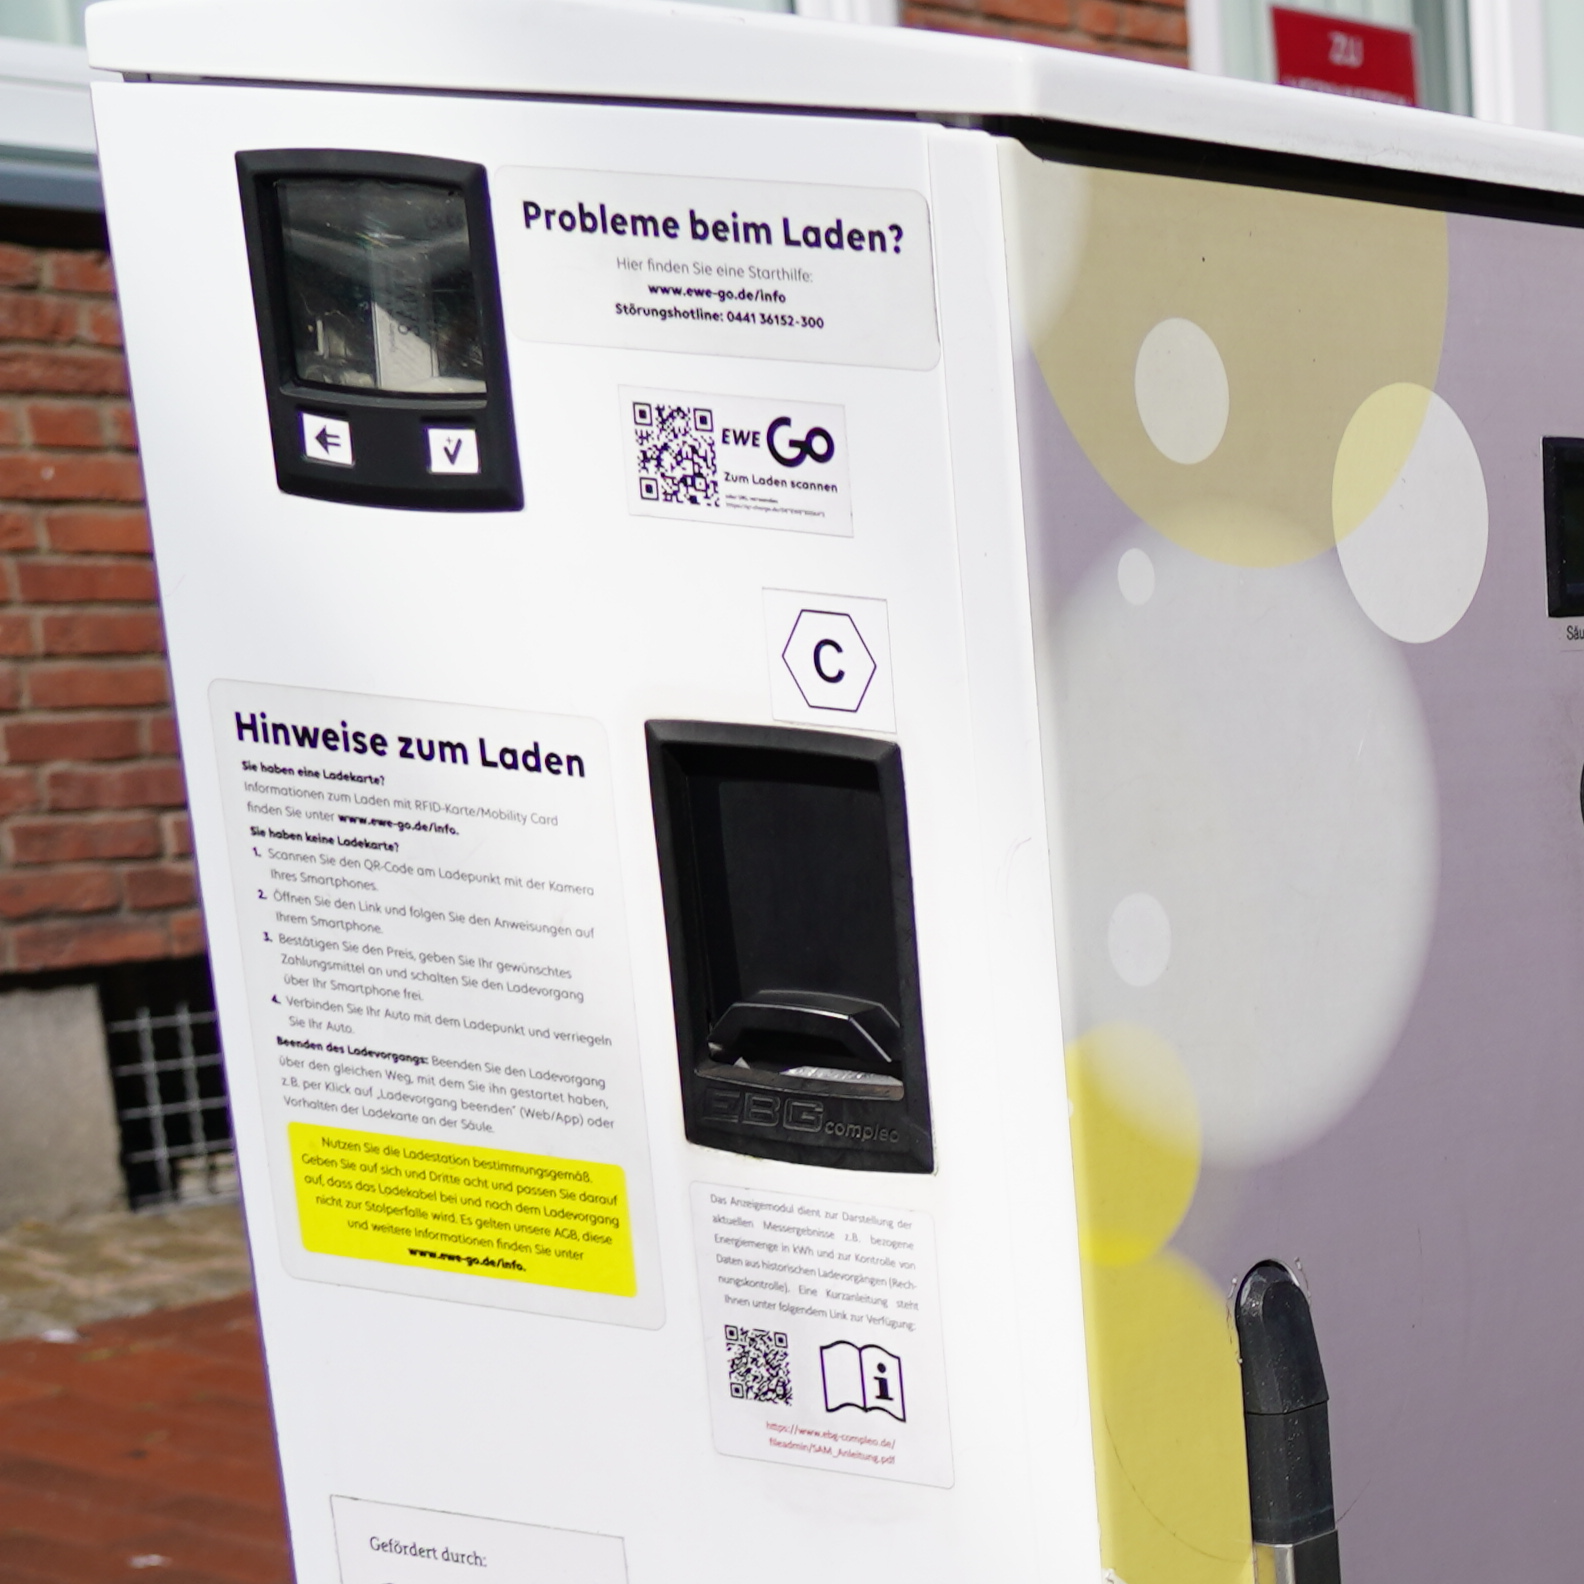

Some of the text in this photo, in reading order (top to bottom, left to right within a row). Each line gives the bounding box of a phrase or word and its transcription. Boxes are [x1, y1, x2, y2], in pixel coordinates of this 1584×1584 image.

[522, 200, 903, 254] Probleme beim Laden?
[616, 256, 813, 283] Hier finden Sie eine Starthilfe:
[614, 302, 824, 329] Störungshotline: 0441 36152-300
[721, 416, 835, 468] EWE Go
[723, 471, 838, 493] Zum Laden scannen
[813, 638, 845, 684] C
[234, 710, 585, 777] Hinweise zum Laden
[240, 759, 385, 785] Sie haben eine Ladekarte?
[243, 780, 558, 825] Informationen zum Laden mit RFID-Karte/Mobility Card
[246, 801, 281, 816] finden
[285, 806, 302, 818] Sie
[305, 809, 335, 822] unter
[249, 825, 399, 852] Sie haben keine Ladekarte?
[267, 847, 317, 863] Scannen
[318, 852, 336, 866] Sie
[338, 855, 361, 868] den
[363, 858, 414, 875] QR-Code
[416, 866, 436, 877] am
[437, 867, 500, 885] Ladepunkt
[503, 876, 522, 887] mit
[525, 878, 545, 889] der
[548, 881, 594, 895] Kamera
[270, 868, 297, 882] Ihres
[272, 888, 312, 905] Öffnen
[313, 894, 331, 908] Sie
[333, 897, 356, 910] den
[357, 900, 382, 913] Link
[384, 905, 406, 917] und
[408, 905, 446, 923] folgen
[447, 910, 465, 923] Sie
[467, 913, 491, 926] den
[493, 916, 572, 937] Anweisungen
[574, 927, 594, 938] auf
[275, 1035, 605, 1090] Beenden des Ladevorgangs: Beenden Sie den Ladevorgang
[703, 1090, 900, 1143] EBG compleo
[321, 1136, 361, 1151] Nutzen
[362, 1141, 380, 1154] Sie
[382, 1144, 400, 1157] die
[402, 1147, 470, 1166] Ladestation
[301, 1152, 617, 1206] Geben Sie auf sich und Dritte acht und passen Sie darauf
[303, 1173, 619, 1229] auf, dass das Ladekabel bei und nach dem Ladevorgang
[315, 1195, 343, 1207] nicht
[345, 1199, 362, 1209] zur
[364, 1200, 428, 1219] Stolperfalle
[459, 1213, 473, 1225] Es
[474, 1217, 511, 1230] gelten
[513, 1223, 551, 1236] unsere
[553, 1227, 580, 1242] AGB,
[581, 1231, 612, 1245] diese
[347, 1219, 584, 1260] und weitere Informationen finden Sie unter
[369, 1535, 486, 1567] Gefördert durch:
